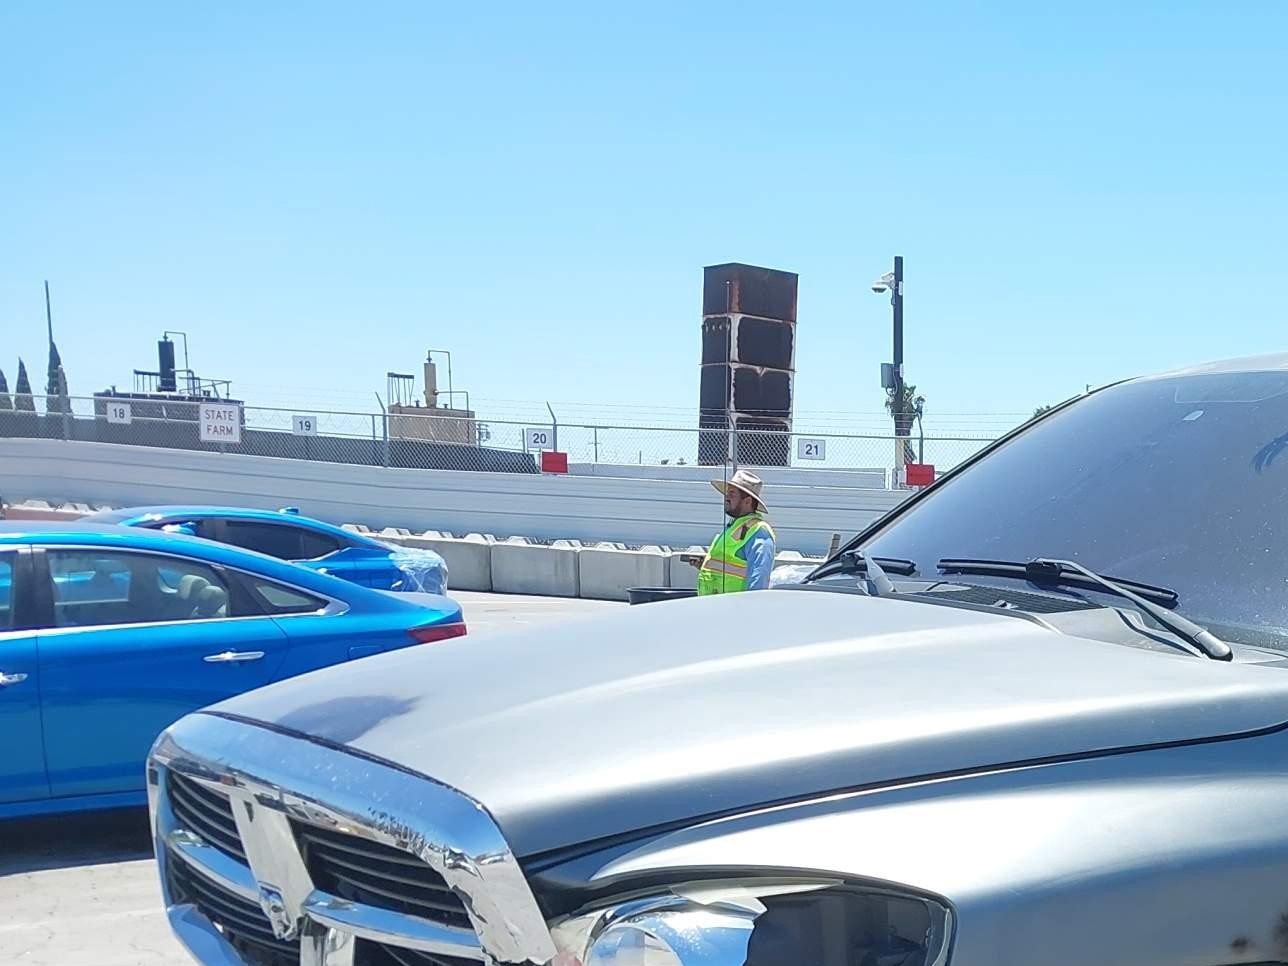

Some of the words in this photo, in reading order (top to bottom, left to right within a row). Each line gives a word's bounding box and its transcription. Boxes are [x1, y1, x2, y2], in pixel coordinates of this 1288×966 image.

[113, 407, 125, 418] 18
[206, 410, 234, 420] STATE
[207, 425, 233, 436] FARM
[299, 421, 311, 432] 19
[533, 433, 546, 444] 20
[805, 444, 819, 455] 21
